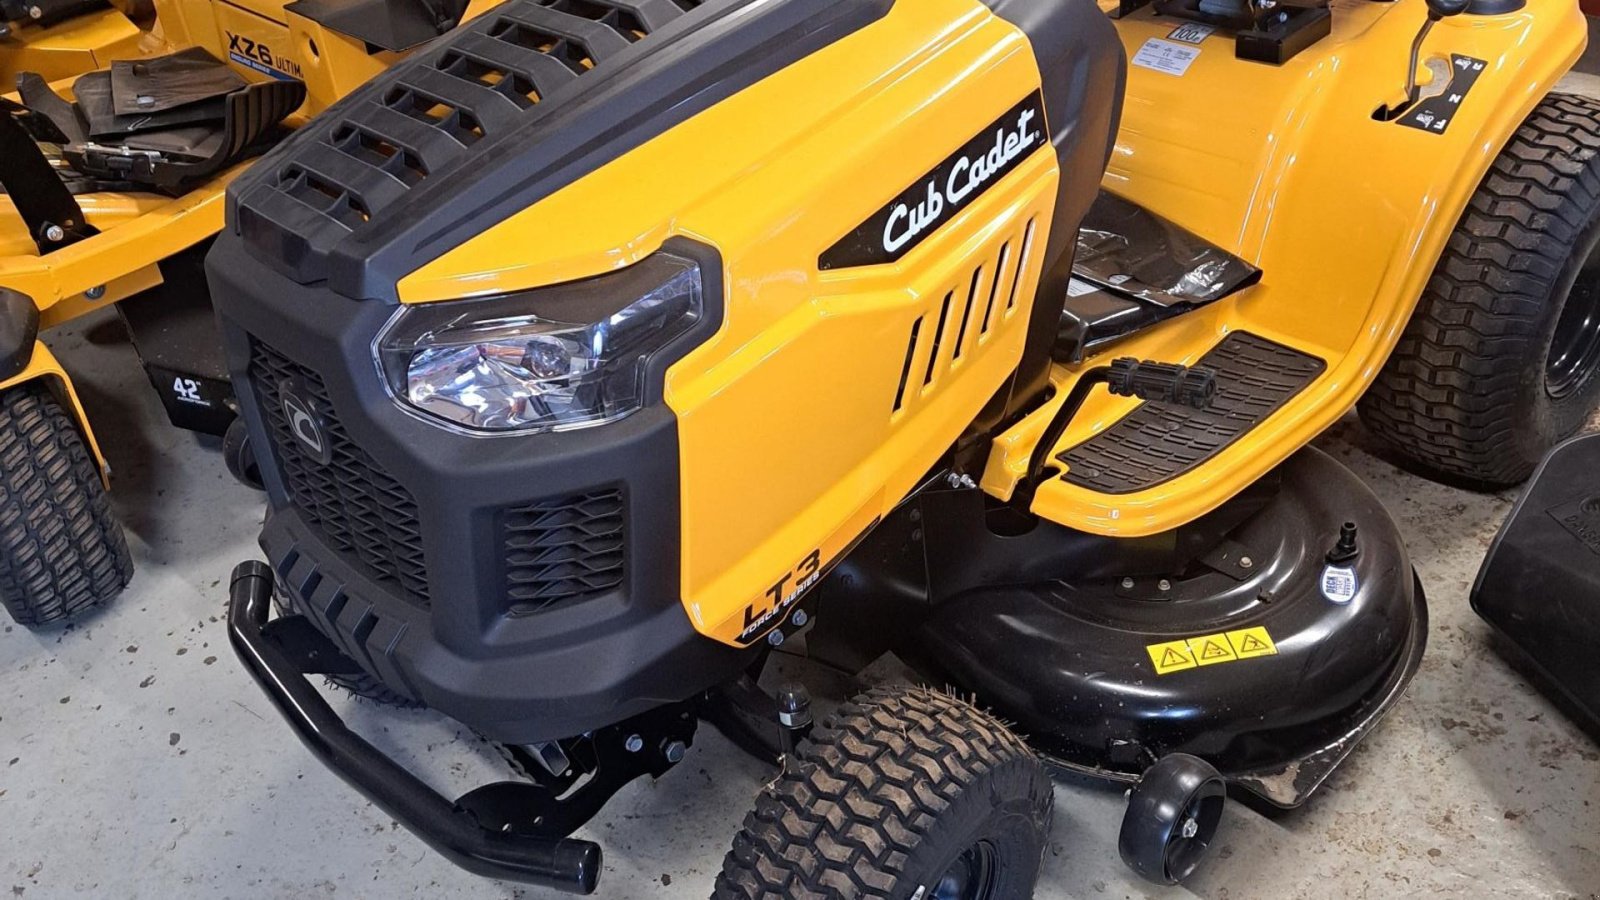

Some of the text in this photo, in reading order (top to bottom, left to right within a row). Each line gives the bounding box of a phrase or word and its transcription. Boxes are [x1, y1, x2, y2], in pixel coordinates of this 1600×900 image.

[225, 30, 304, 79] XZ6 ULTIM
[1472, 62, 1483, 71] R
[1448, 93, 1462, 104] N
[1433, 119, 1447, 130] F
[882, 180, 944, 253] Cub
[1326, 576, 1336, 593] DECK
[741, 569, 820, 639] FORCE SERIES
